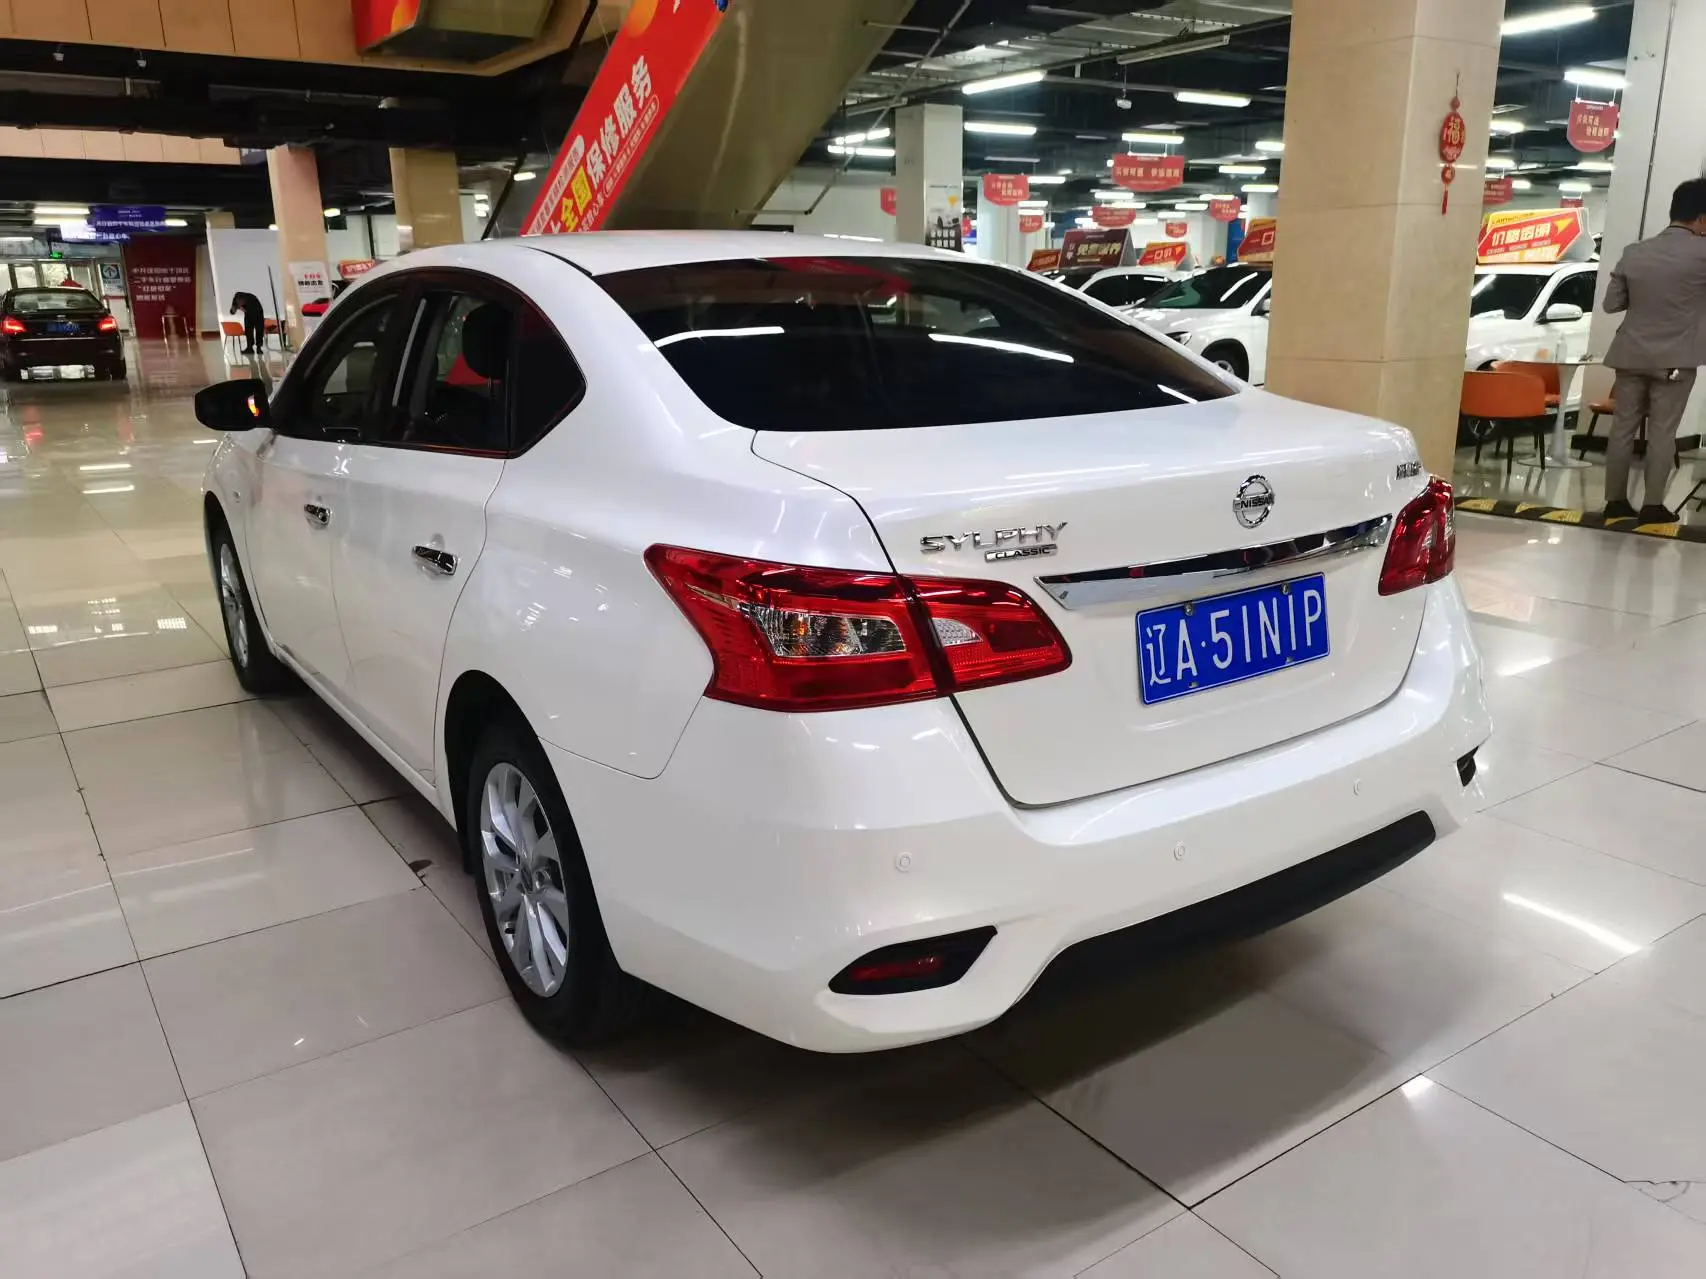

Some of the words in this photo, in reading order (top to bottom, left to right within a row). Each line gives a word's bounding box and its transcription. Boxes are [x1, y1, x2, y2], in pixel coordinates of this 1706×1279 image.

[1240, 494, 1274, 509] NISSAN
[920, 521, 1068, 554] SYLPHY
[992, 546, 1052, 560] CLASSIC
